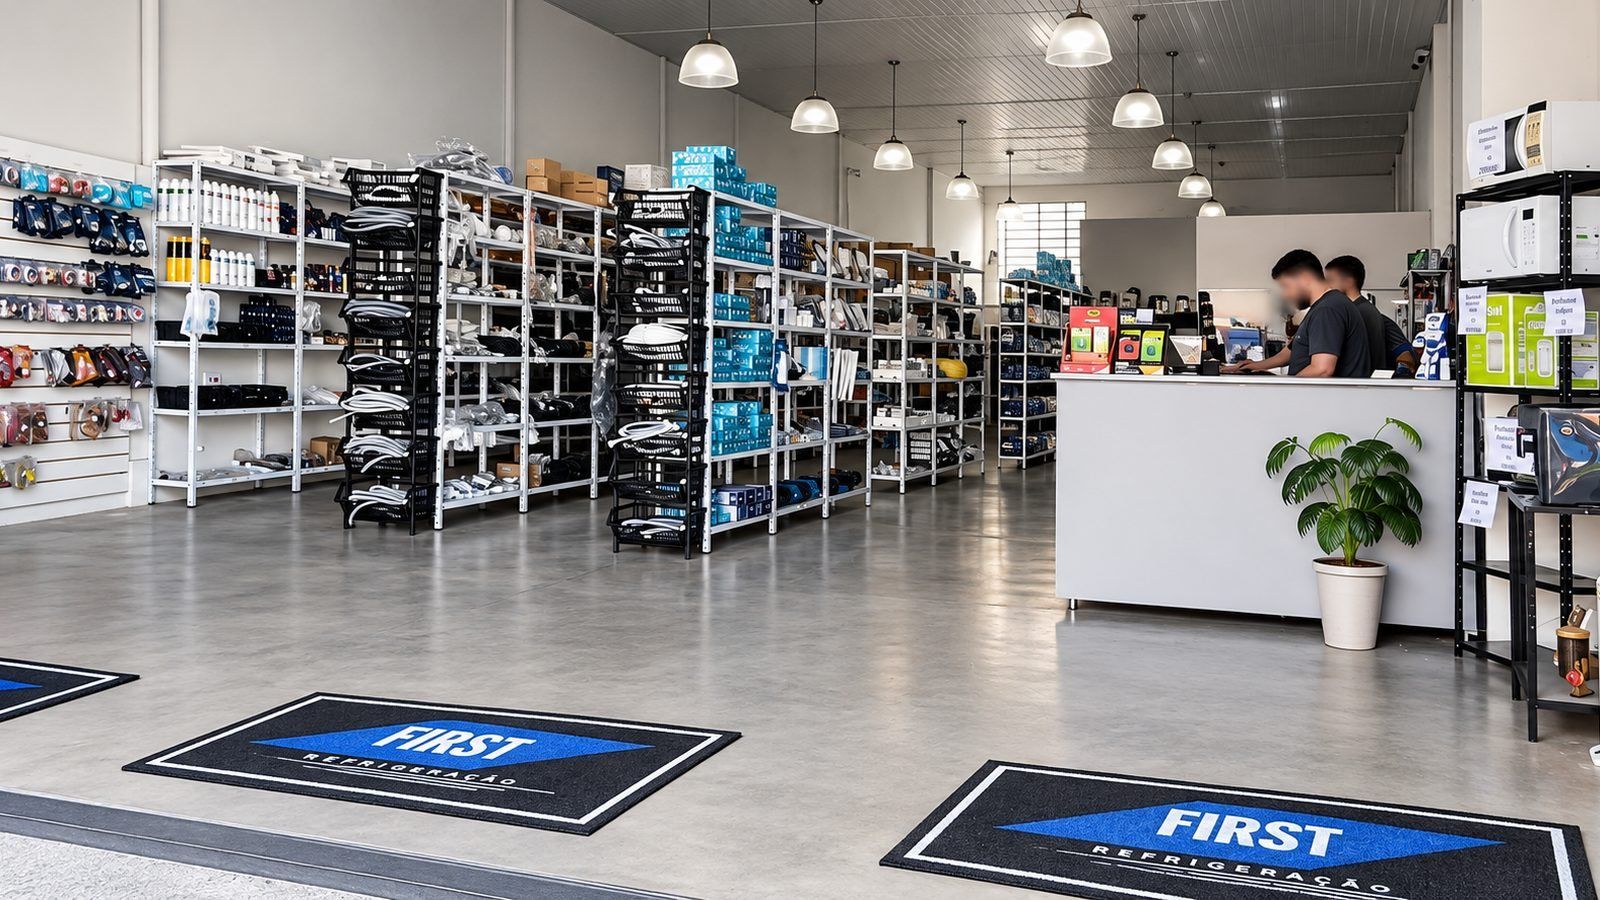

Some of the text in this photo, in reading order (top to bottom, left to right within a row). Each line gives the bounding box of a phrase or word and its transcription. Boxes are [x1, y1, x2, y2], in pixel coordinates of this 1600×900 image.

[372, 726, 537, 760] FIRST
[303, 753, 516, 786] REFRIGERAÇÃO
[1156, 808, 1343, 857] FIRST
[1092, 845, 1391, 894] REFRIGERAÇÃO
